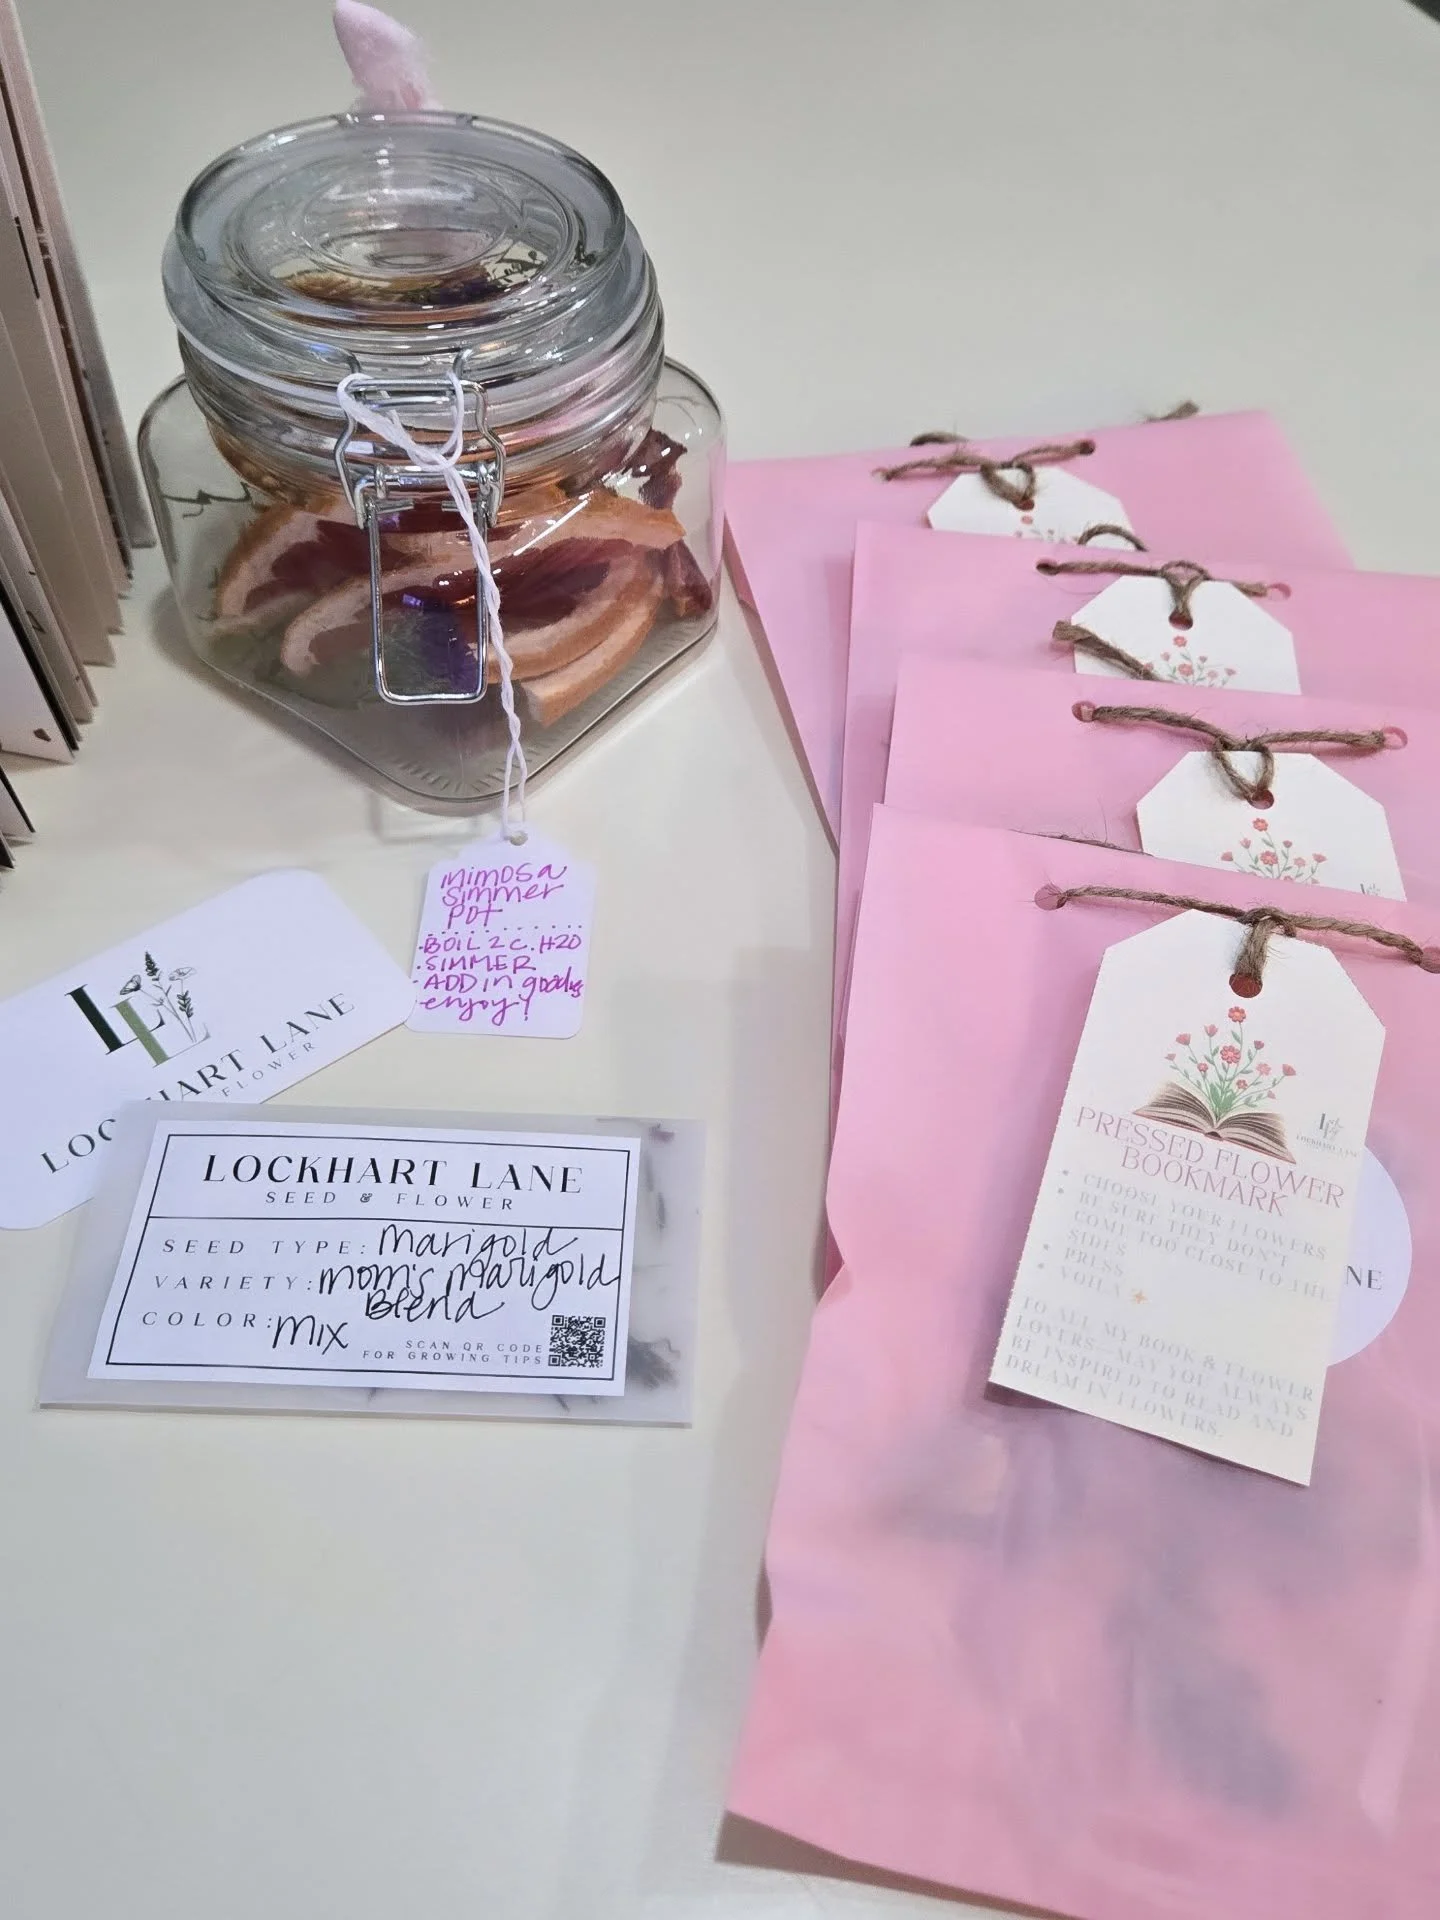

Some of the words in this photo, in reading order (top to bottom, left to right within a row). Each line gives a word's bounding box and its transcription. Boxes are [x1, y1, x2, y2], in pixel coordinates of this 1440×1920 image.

[426, 955, 537, 974] SIMMER
[423, 973, 478, 993] ADD
[221, 1041, 315, 1097] FLOWER
[40, 1049, 245, 1174] LOCART
[260, 993, 355, 1053] LANE
[1076, 1105, 1205, 1164] PRESSED
[1214, 1147, 1345, 1209] FLOWER
[203, 1154, 447, 1187] LOCKHART
[471, 1162, 583, 1194] LANE
[1121, 1145, 1288, 1217] BOOKMARK
[1084, 1173, 1160, 1206] CHOOSE
[265, 1191, 336, 1204] SEED
[360, 1192, 373, 1203] &
[396, 1193, 513, 1210] FLOWER
[162, 1239, 244, 1254] SEED
[273, 1240, 366, 1255] TYPE:
[155, 1276, 312, 1291] VARIETY:
[142, 1311, 272, 1329] COLOR:
[405, 1340, 450, 1350] SCAN
[464, 1341, 484, 1352] QR
[497, 1342, 542, 1353] CODE
[1140, 1334, 1195, 1363] BOOK
[1203, 1355, 1216, 1371] &
[362, 1350, 395, 1360] FOR
[408, 1351, 490, 1364] GROWING
[504, 1354, 541, 1365] TIPS
